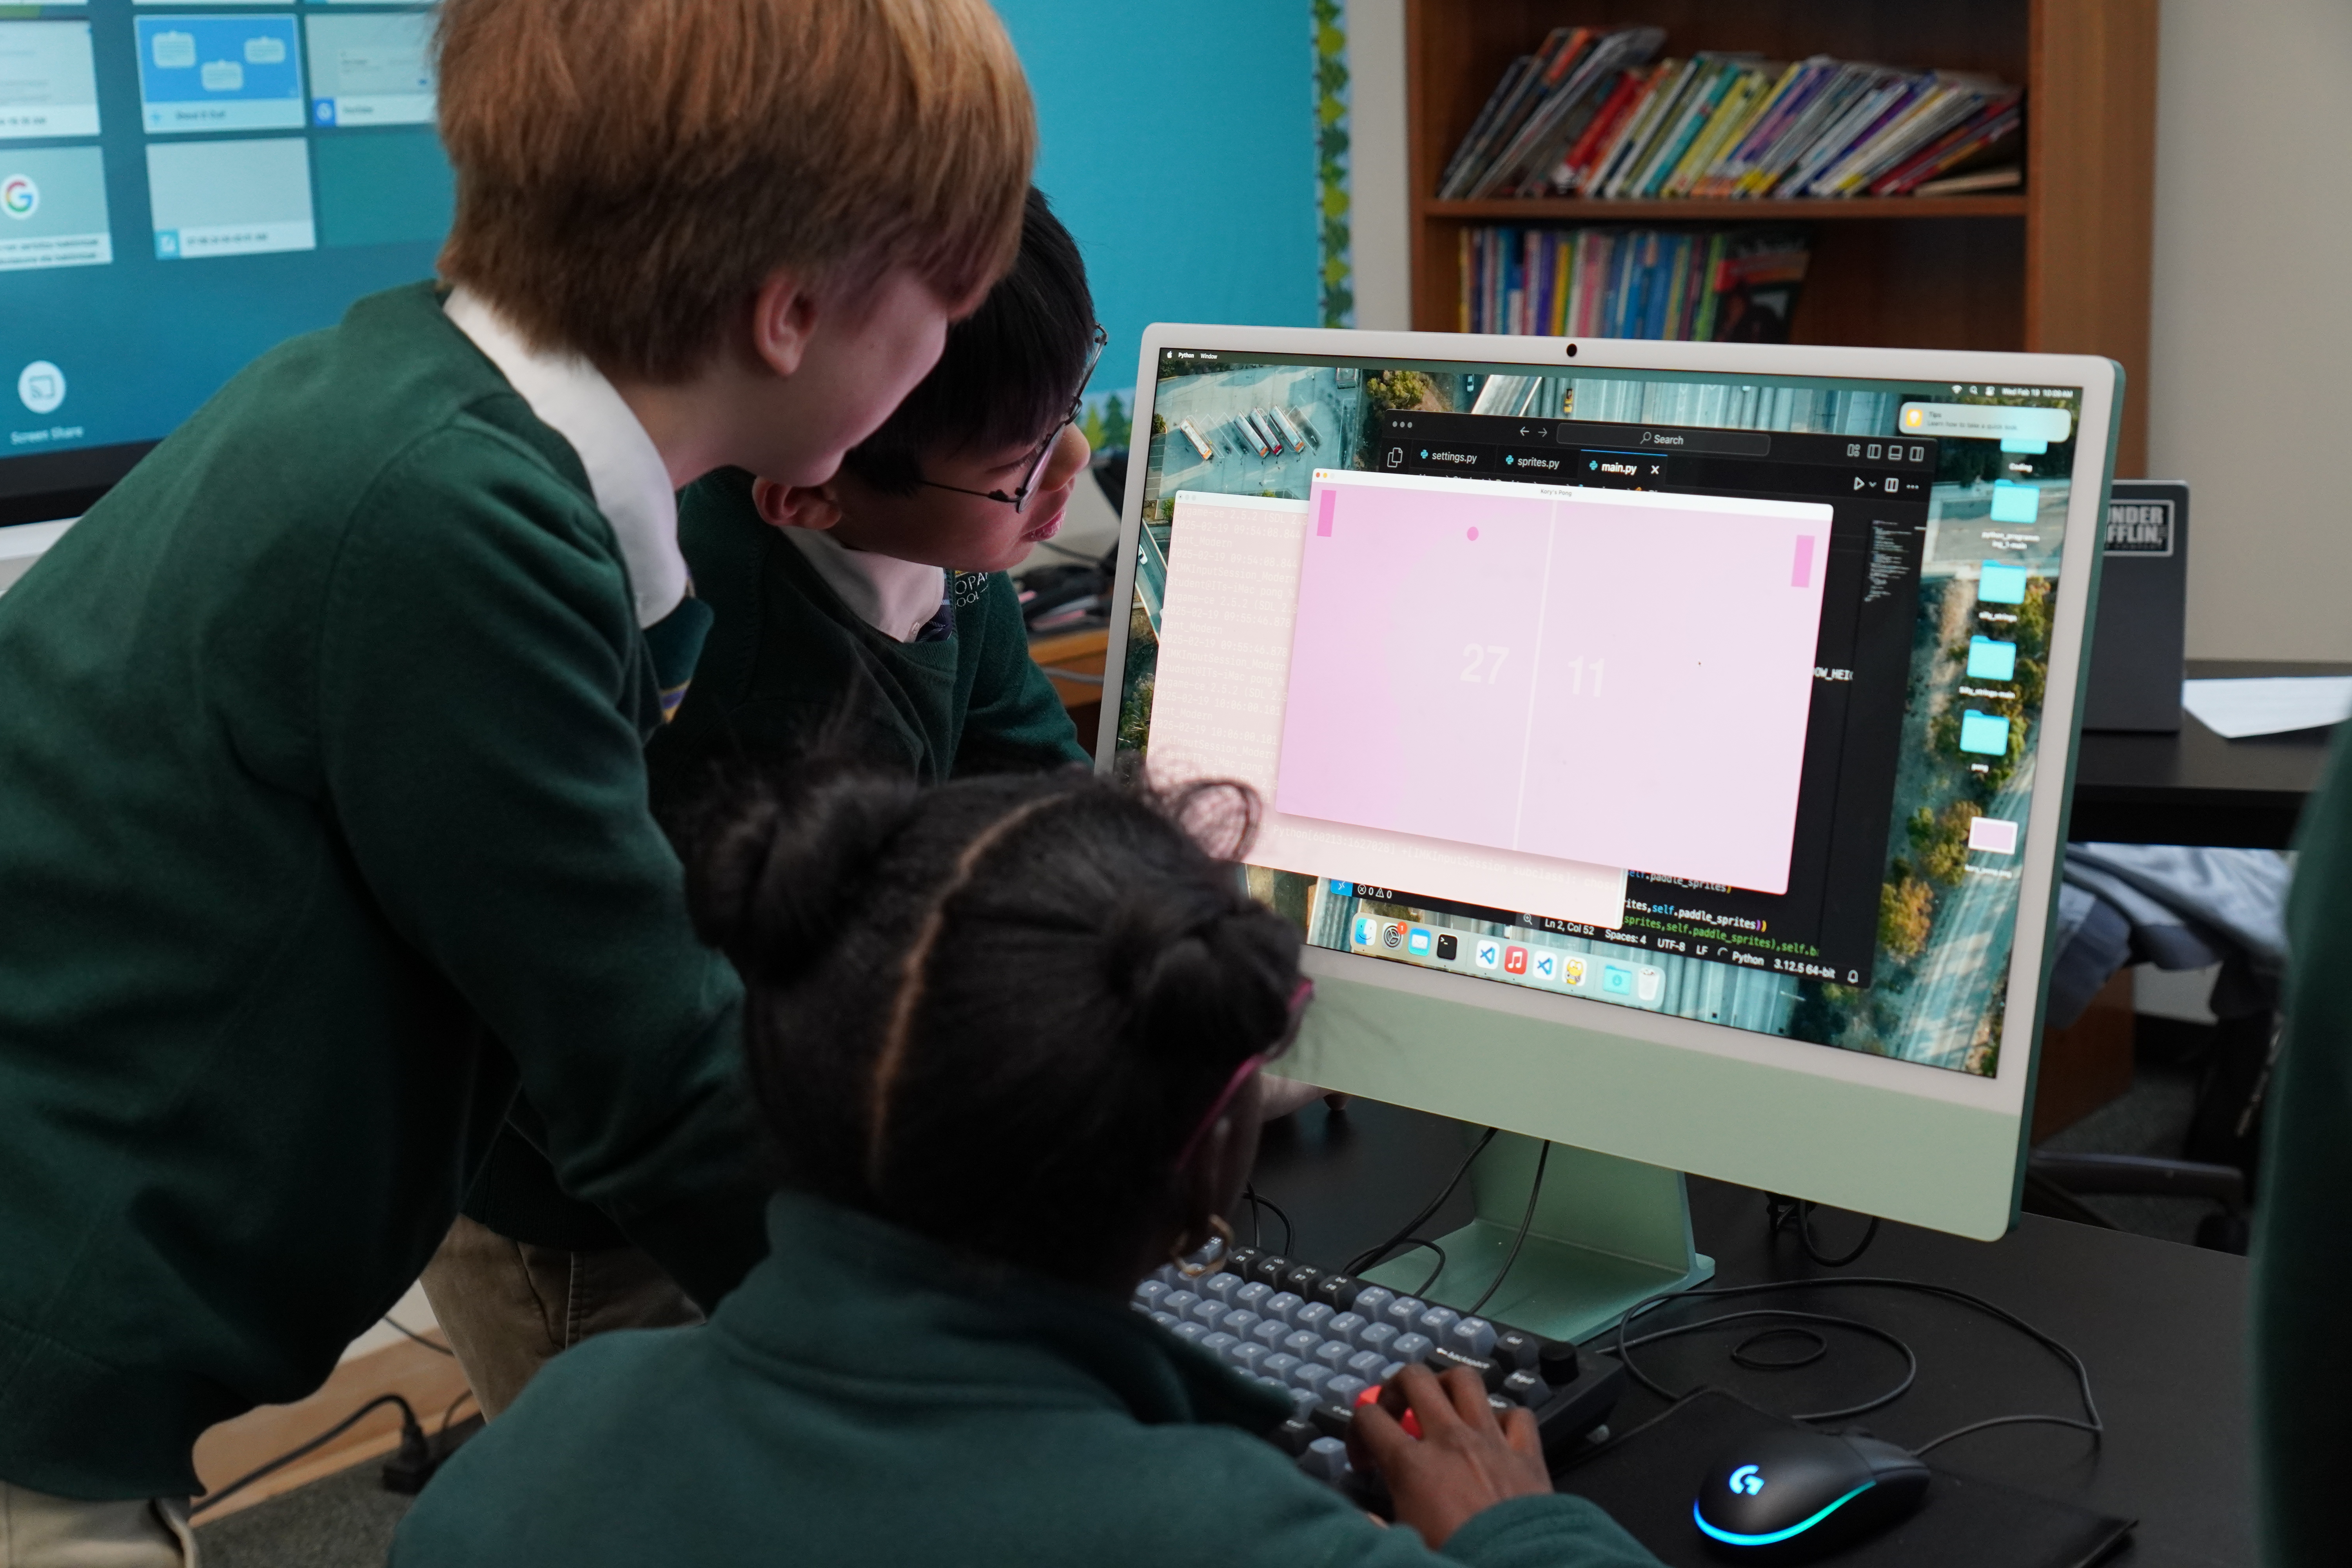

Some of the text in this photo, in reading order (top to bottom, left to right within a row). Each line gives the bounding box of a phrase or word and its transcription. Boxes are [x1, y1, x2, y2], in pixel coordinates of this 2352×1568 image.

[1654, 434, 1684, 445] Search
[1432, 451, 1477, 464] settings.py
[1517, 457, 1560, 469] sprites.py
[1601, 462, 1637, 475] main.py
[1176, 506, 1224, 518] pygame-ce
[1230, 510, 1257, 521] 2.5.2
[1264, 512, 1285, 523] (SDL
[2108, 506, 2164, 524] NDER
[1174, 520, 1301, 540] 2025-02-19 09:54:08.844
[1173, 534, 1232, 548] ient_Modern
[1171, 548, 1298, 569] 2025-02-19 09:54:08.844
[1175, 563, 1296, 584] IMKInputSession_Modern
[1168, 577, 1295, 599] Student@ITs-iMac pong %
[955, 591, 979, 610] OOL
[1166, 592, 1214, 604] pygame-ce
[1220, 597, 1247, 608] 2.5.2
[1254, 600, 1275, 611] (SDL
[1165, 605, 1291, 627] 2025-02-19 09:55:46.878
[1163, 619, 1223, 634] ient_Modern
[1162, 633, 1288, 657] 2025-02-19 09:55:46.878
[1165, 648, 1286, 672] IMKInputSession_Modern
[1460, 643, 1510, 685] 27
[1158, 662, 1285, 687] Student@ITs-iMac pong %
[1568, 655, 1605, 697] 11
[1157, 677, 1205, 691] pygame-ce
[1210, 683, 1238, 695] 2.5.2
[1245, 687, 1265, 699] (SDL
[1154, 704, 1212, 721] ient_Modern
[1156, 690, 1281, 716] 2025-02-19 10:06:00.101
[1152, 718, 1277, 745] 2025-02-19 10:06:00.101
[1156, 733, 1276, 759] IMKInputSession_Modern
[1241, 763, 1263, 773] pong
[1268, 764, 1275, 774] %
[1584, 878, 1617, 891] chose
[1628, 869, 1731, 894] elf.paddle_sprites)
[1368, 887, 1374, 896] 0
[1387, 890, 1392, 899] 0
[1624, 898, 1767, 933] ites,self.paddle_sprites))
[1545, 919, 1595, 935] Ln 2, Col 52
[1605, 929, 1647, 945] Spaces: 4
[1657, 938, 1686, 952] UTF-8
[1696, 945, 1708, 955] LF
[1732, 951, 1764, 966] Python
[1774, 958, 1836, 978] 3.12.5 64-bit
